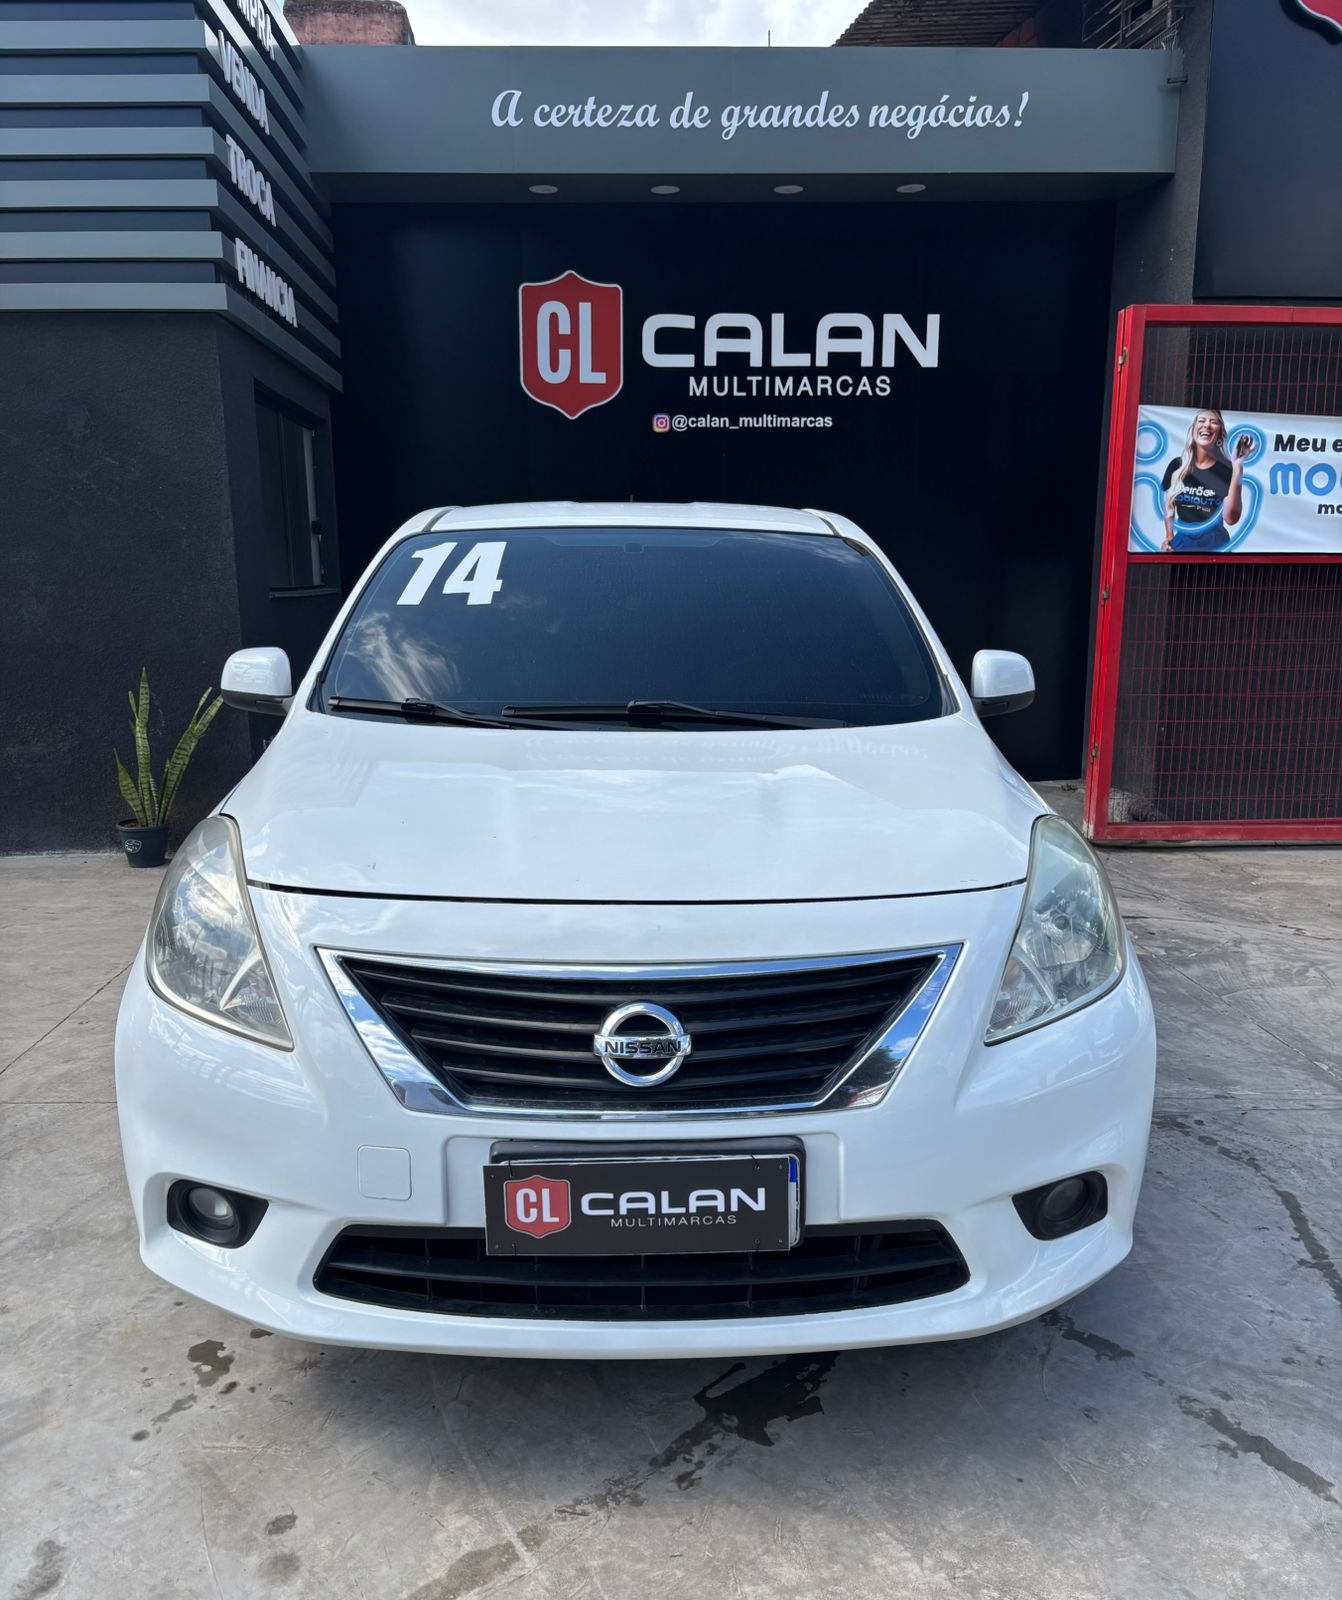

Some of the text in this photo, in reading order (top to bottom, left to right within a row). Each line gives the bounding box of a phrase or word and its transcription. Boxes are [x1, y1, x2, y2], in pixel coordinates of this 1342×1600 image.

[217, 29, 270, 135] VENDA
[491, 89, 1029, 141] A certeza de grandes negócios!
[225, 133, 277, 228] TROCA
[234, 236, 298, 329] FINANCIA
[536, 300, 607, 384] CL
[641, 312, 941, 368] CALAN
[689, 375, 891, 397] MULTIMARCAS
[671, 413, 833, 432] @calan_multimarcas
[1273, 433, 1327, 453] Meu
[1269, 462, 1342, 497] mo
[396, 541, 507, 605] 14
[604, 1040, 682, 1054] NISSAN
[515, 1188, 560, 1223] CL
[580, 1187, 766, 1216] CALAN
[610, 1214, 738, 1228] MULTIMARCAS
